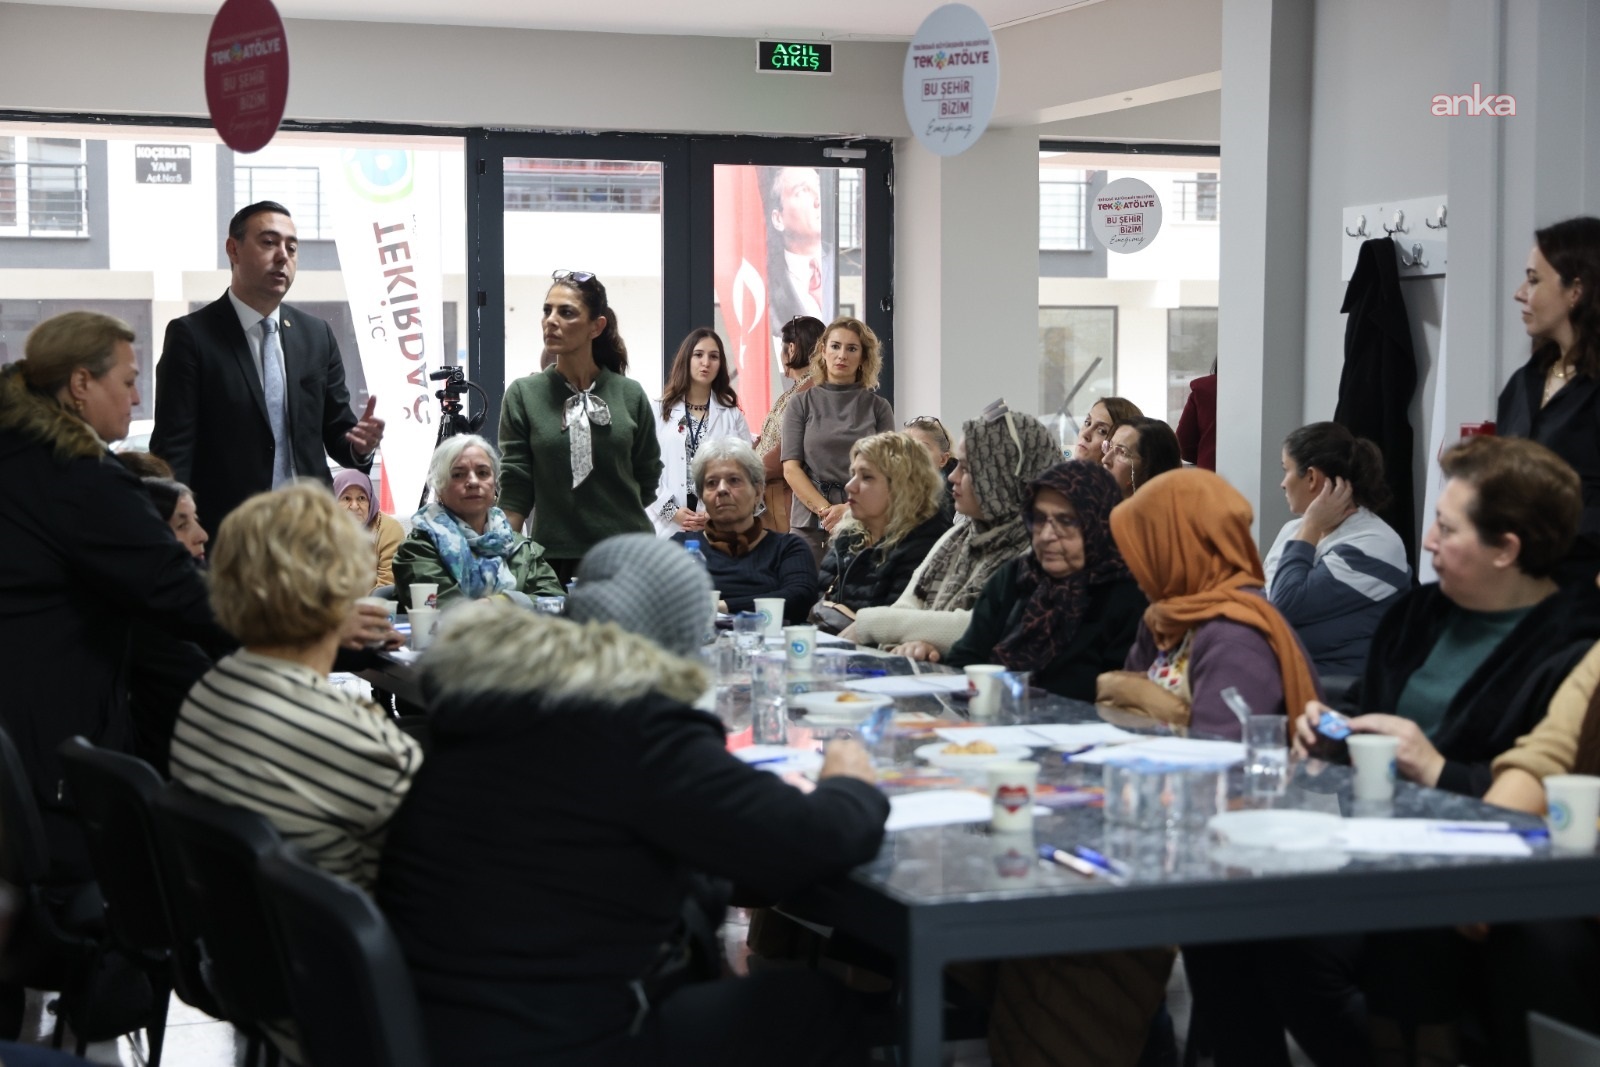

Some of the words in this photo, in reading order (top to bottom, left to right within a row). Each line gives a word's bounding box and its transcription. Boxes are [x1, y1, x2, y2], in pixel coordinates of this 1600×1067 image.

[773, 43, 820, 56] ACİL
[771, 55, 820, 70] ÇIKIŞ
[946, 48, 990, 67] ATÖLYE
[924, 83, 938, 96] BU
[941, 80, 970, 99] ŞEHİR
[941, 100, 969, 116] BİZİM
[150, 161, 177, 172] YAPI
[1123, 200, 1154, 209] ATÖLYE
[1119, 215, 1141, 225] ŞEHİR
